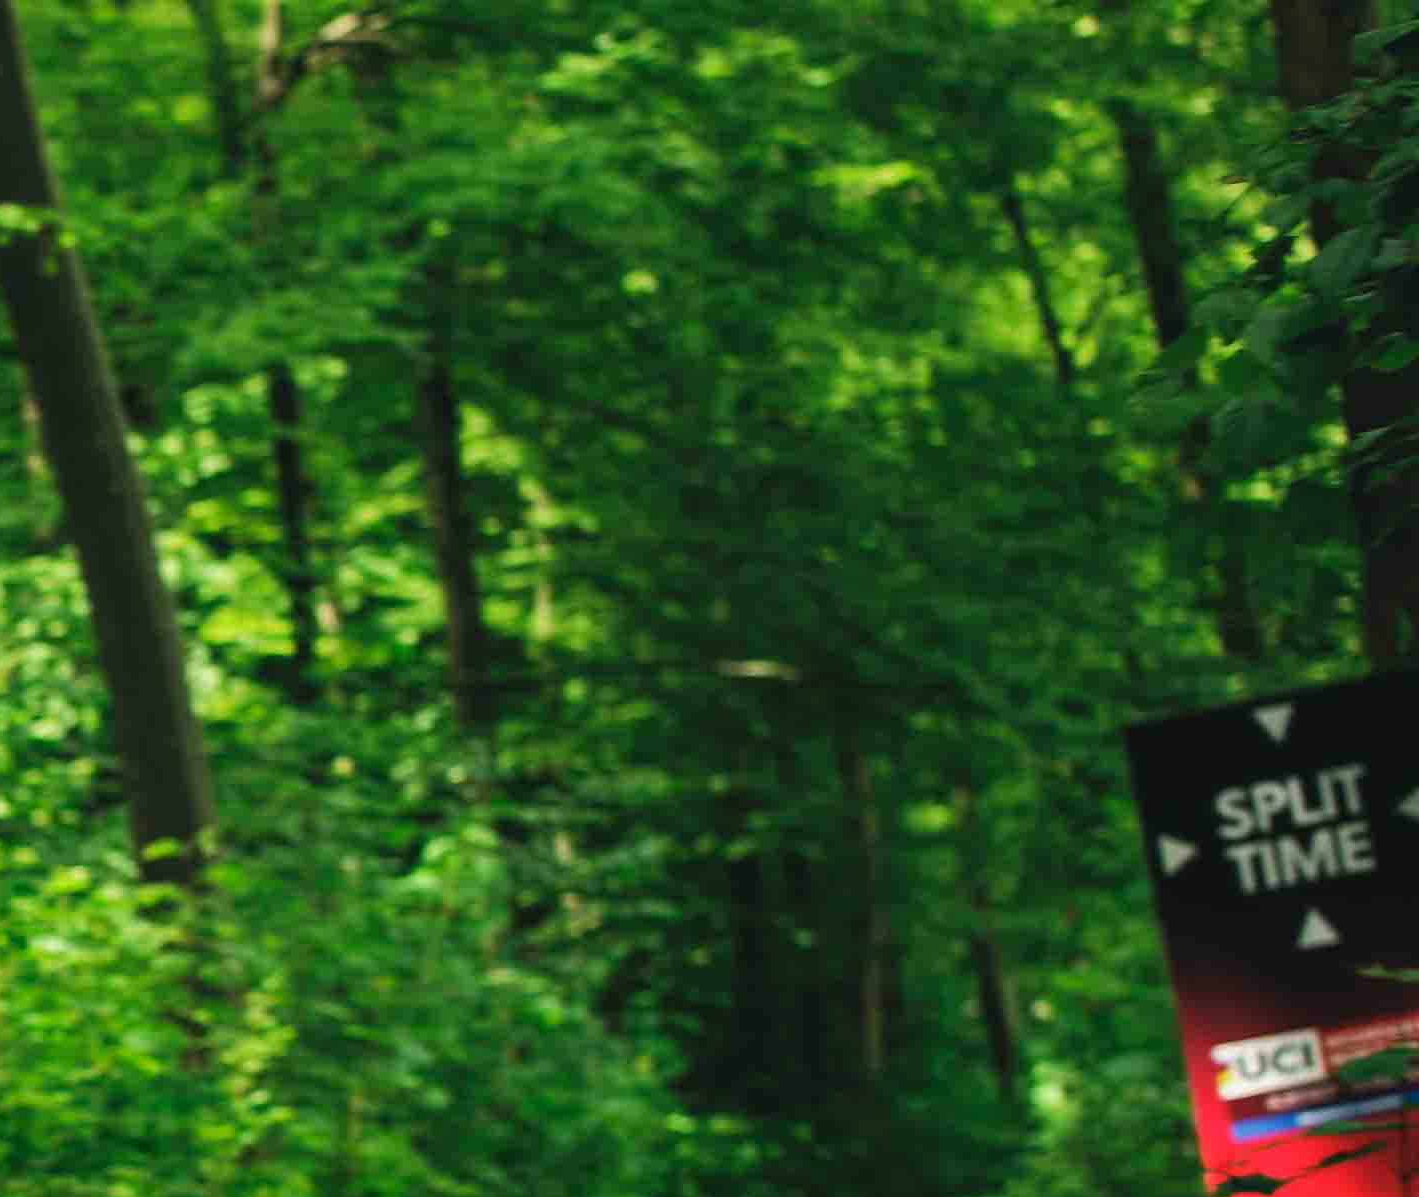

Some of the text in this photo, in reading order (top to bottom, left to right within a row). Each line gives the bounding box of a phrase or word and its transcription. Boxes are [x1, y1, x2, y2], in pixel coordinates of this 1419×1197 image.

[1215, 764, 1367, 841] SPLIT
[1226, 820, 1377, 892] TIME
[1236, 1042, 1315, 1081] UCI
